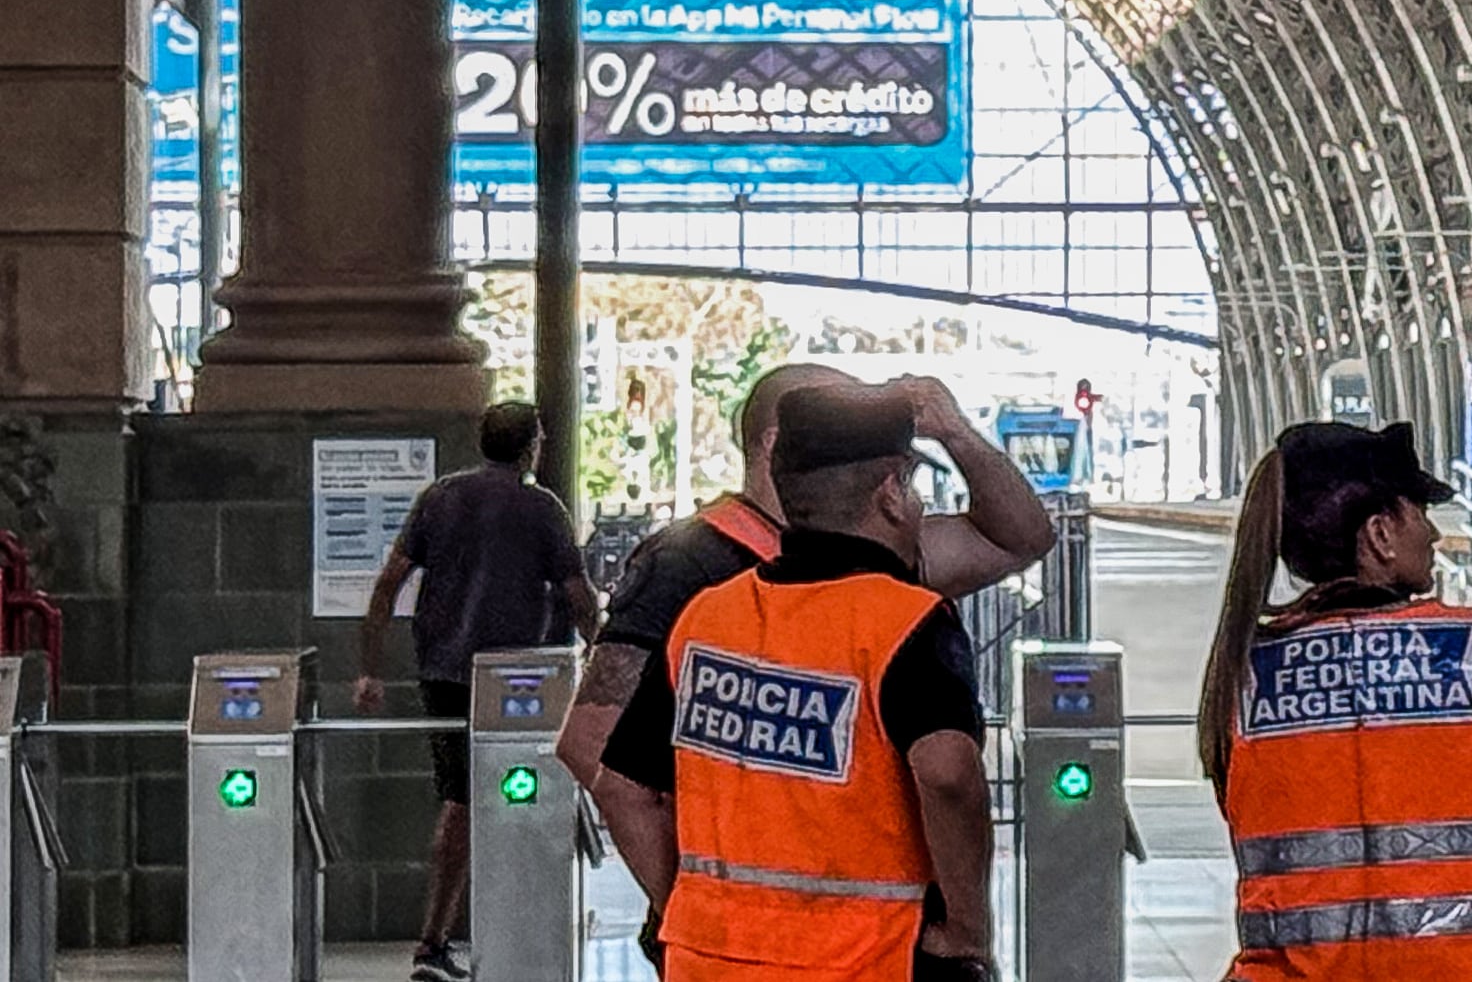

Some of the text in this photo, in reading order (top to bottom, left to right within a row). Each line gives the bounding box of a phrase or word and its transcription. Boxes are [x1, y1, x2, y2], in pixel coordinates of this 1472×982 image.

[683, 81, 934, 114] más de crédito
[1275, 657, 1442, 693] FEDERAL
[1254, 681, 1470, 723] ARGENTINA
